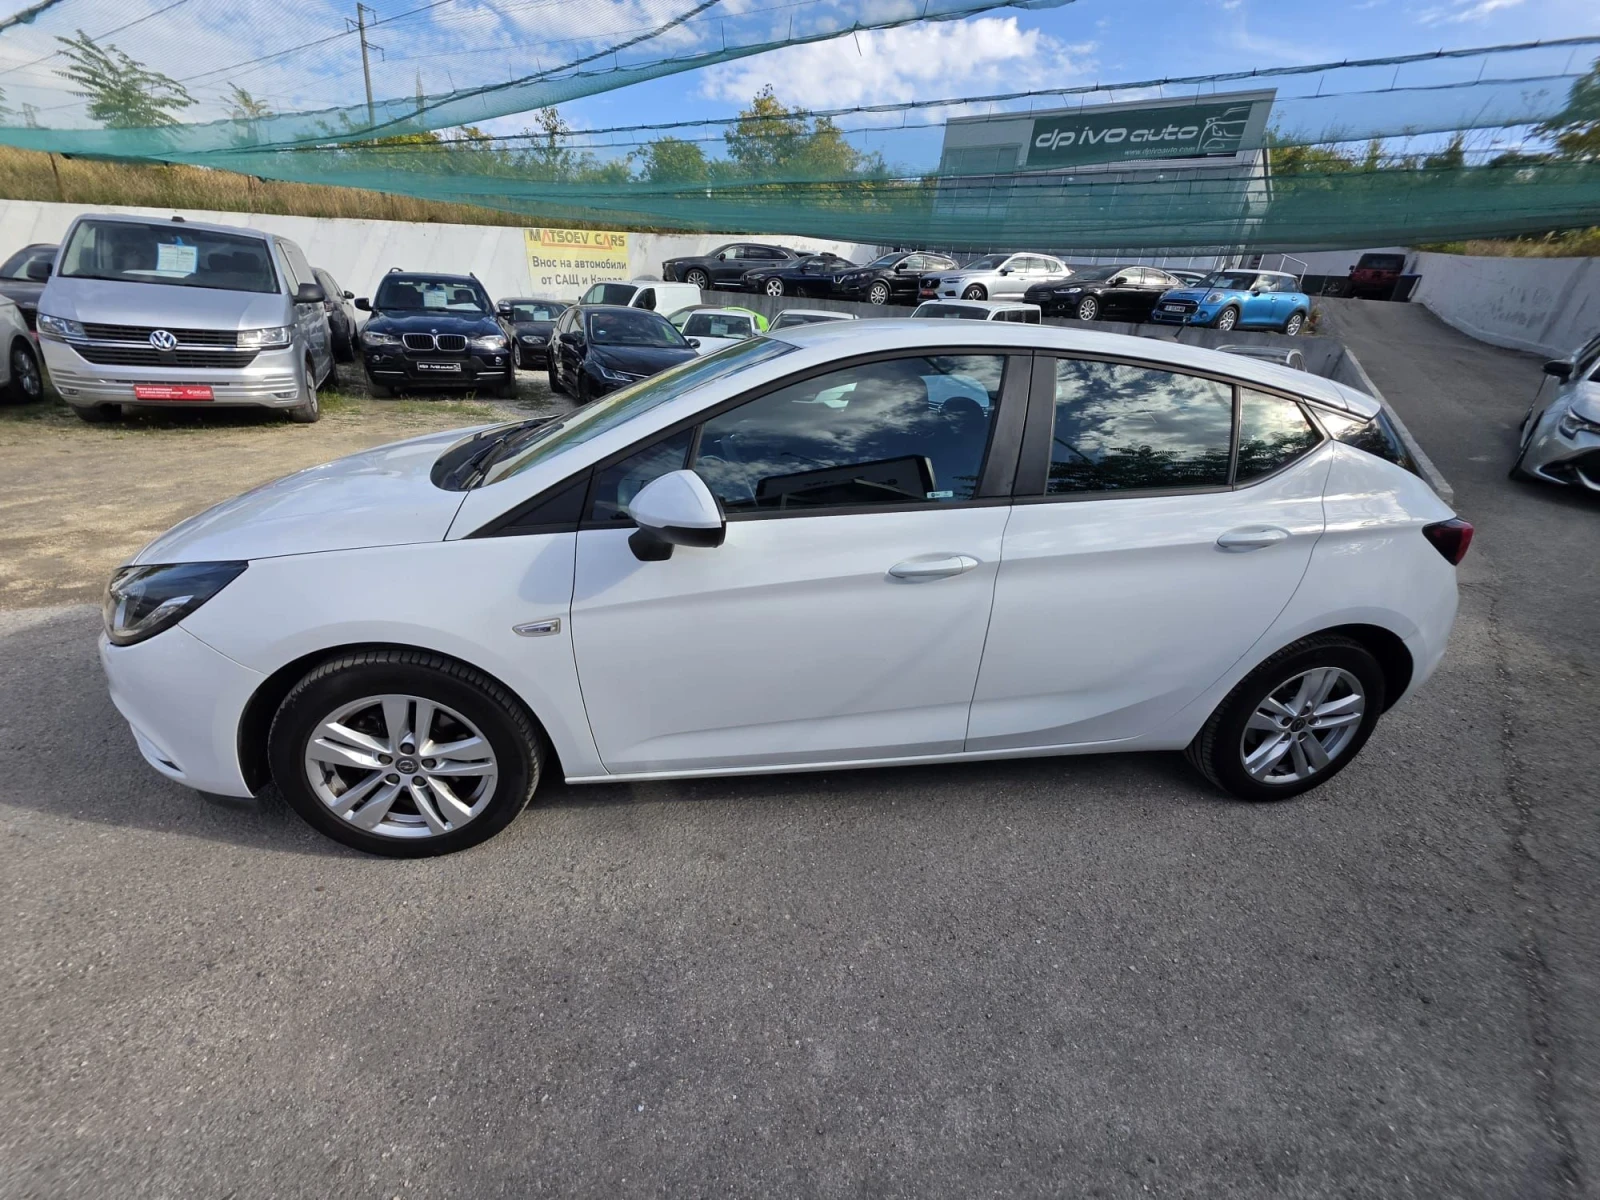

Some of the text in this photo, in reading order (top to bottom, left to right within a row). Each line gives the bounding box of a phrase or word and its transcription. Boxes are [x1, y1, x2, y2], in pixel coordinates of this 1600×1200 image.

[1035, 124, 1200, 151] dp ivo auto
[529, 228, 625, 247] MATSOEV CARS
[532, 255, 627, 270] Внос на автомобили
[541, 275, 552, 285] от
[555, 274, 580, 287] САЩ
[582, 276, 588, 284] и
